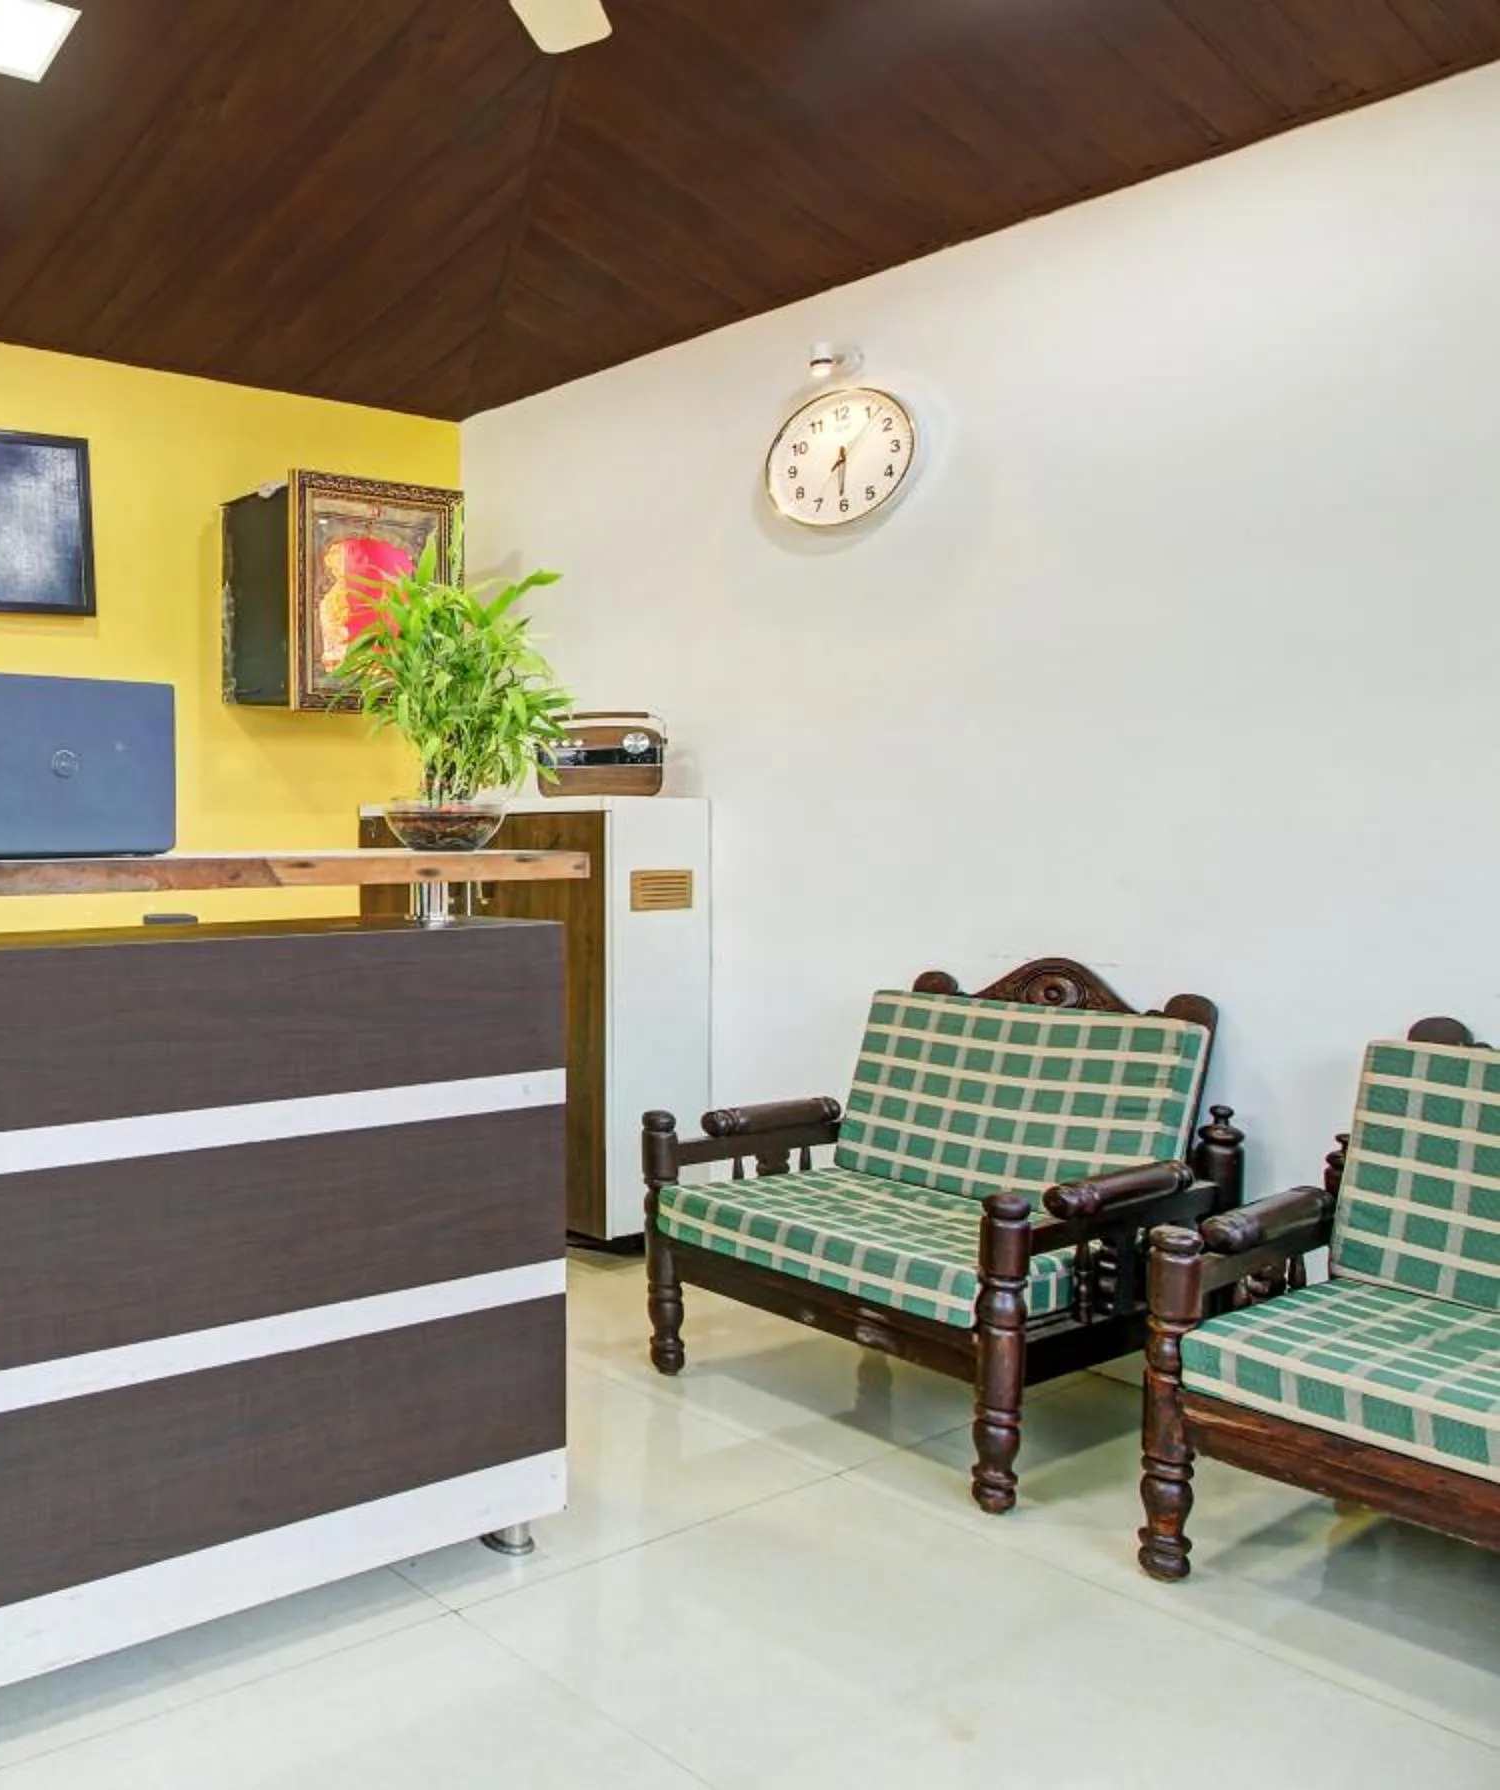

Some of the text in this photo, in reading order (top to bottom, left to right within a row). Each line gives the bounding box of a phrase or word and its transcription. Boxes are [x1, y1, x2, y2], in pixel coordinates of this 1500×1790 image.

[833, 405, 850, 421] 12
[864, 405, 871, 419] 1
[809, 419, 823, 434] 11
[882, 417, 893, 432] 2
[791, 441, 809, 457] 10
[890, 439, 901, 453] 3
[787, 465, 798, 479] 9
[883, 464, 895, 478] 4
[795, 486, 805, 500] 8
[865, 485, 876, 501] 5
[813, 498, 825, 513] 7
[839, 498, 849, 513] 6
